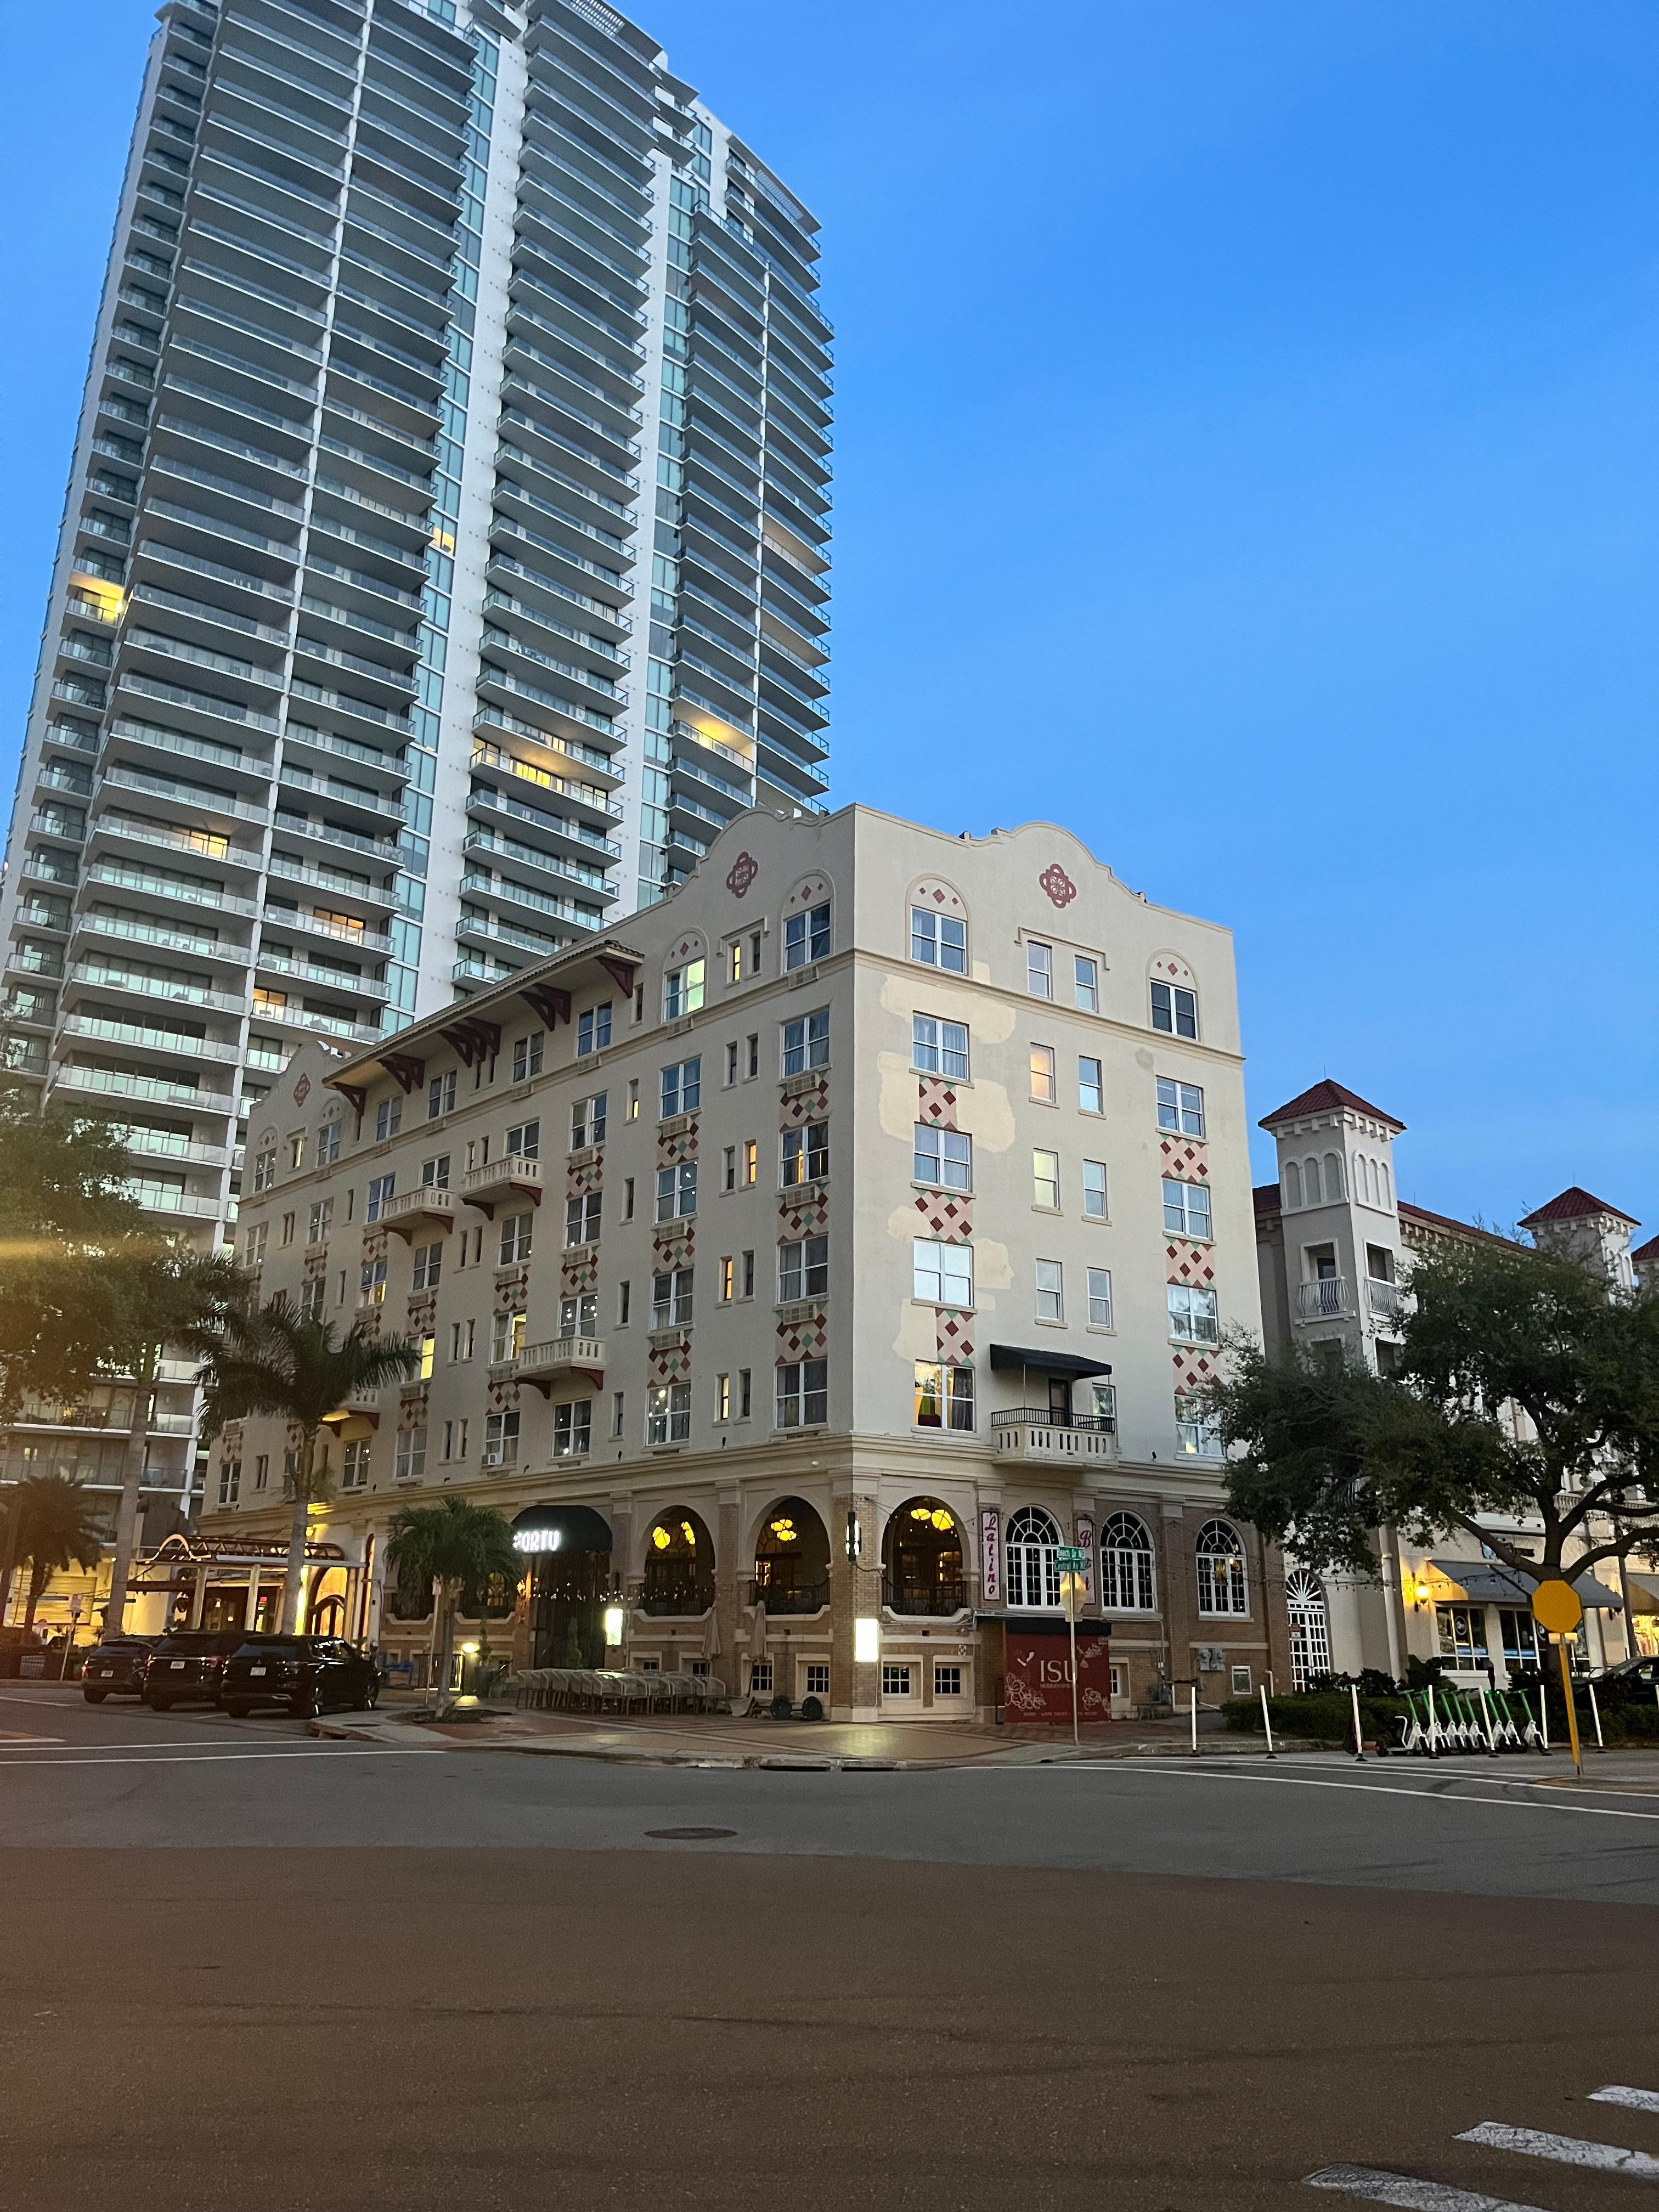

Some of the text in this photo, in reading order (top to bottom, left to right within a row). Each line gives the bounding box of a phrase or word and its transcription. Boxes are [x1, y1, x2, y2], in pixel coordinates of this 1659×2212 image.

[984, 1516, 996, 1594] Latino
[1058, 1548, 1070, 1557] Beach
[1071, 1549, 1077, 1558] Dr
[1055, 1561, 1071, 1570] Central
[1040, 1660, 1078, 1683] ISU
